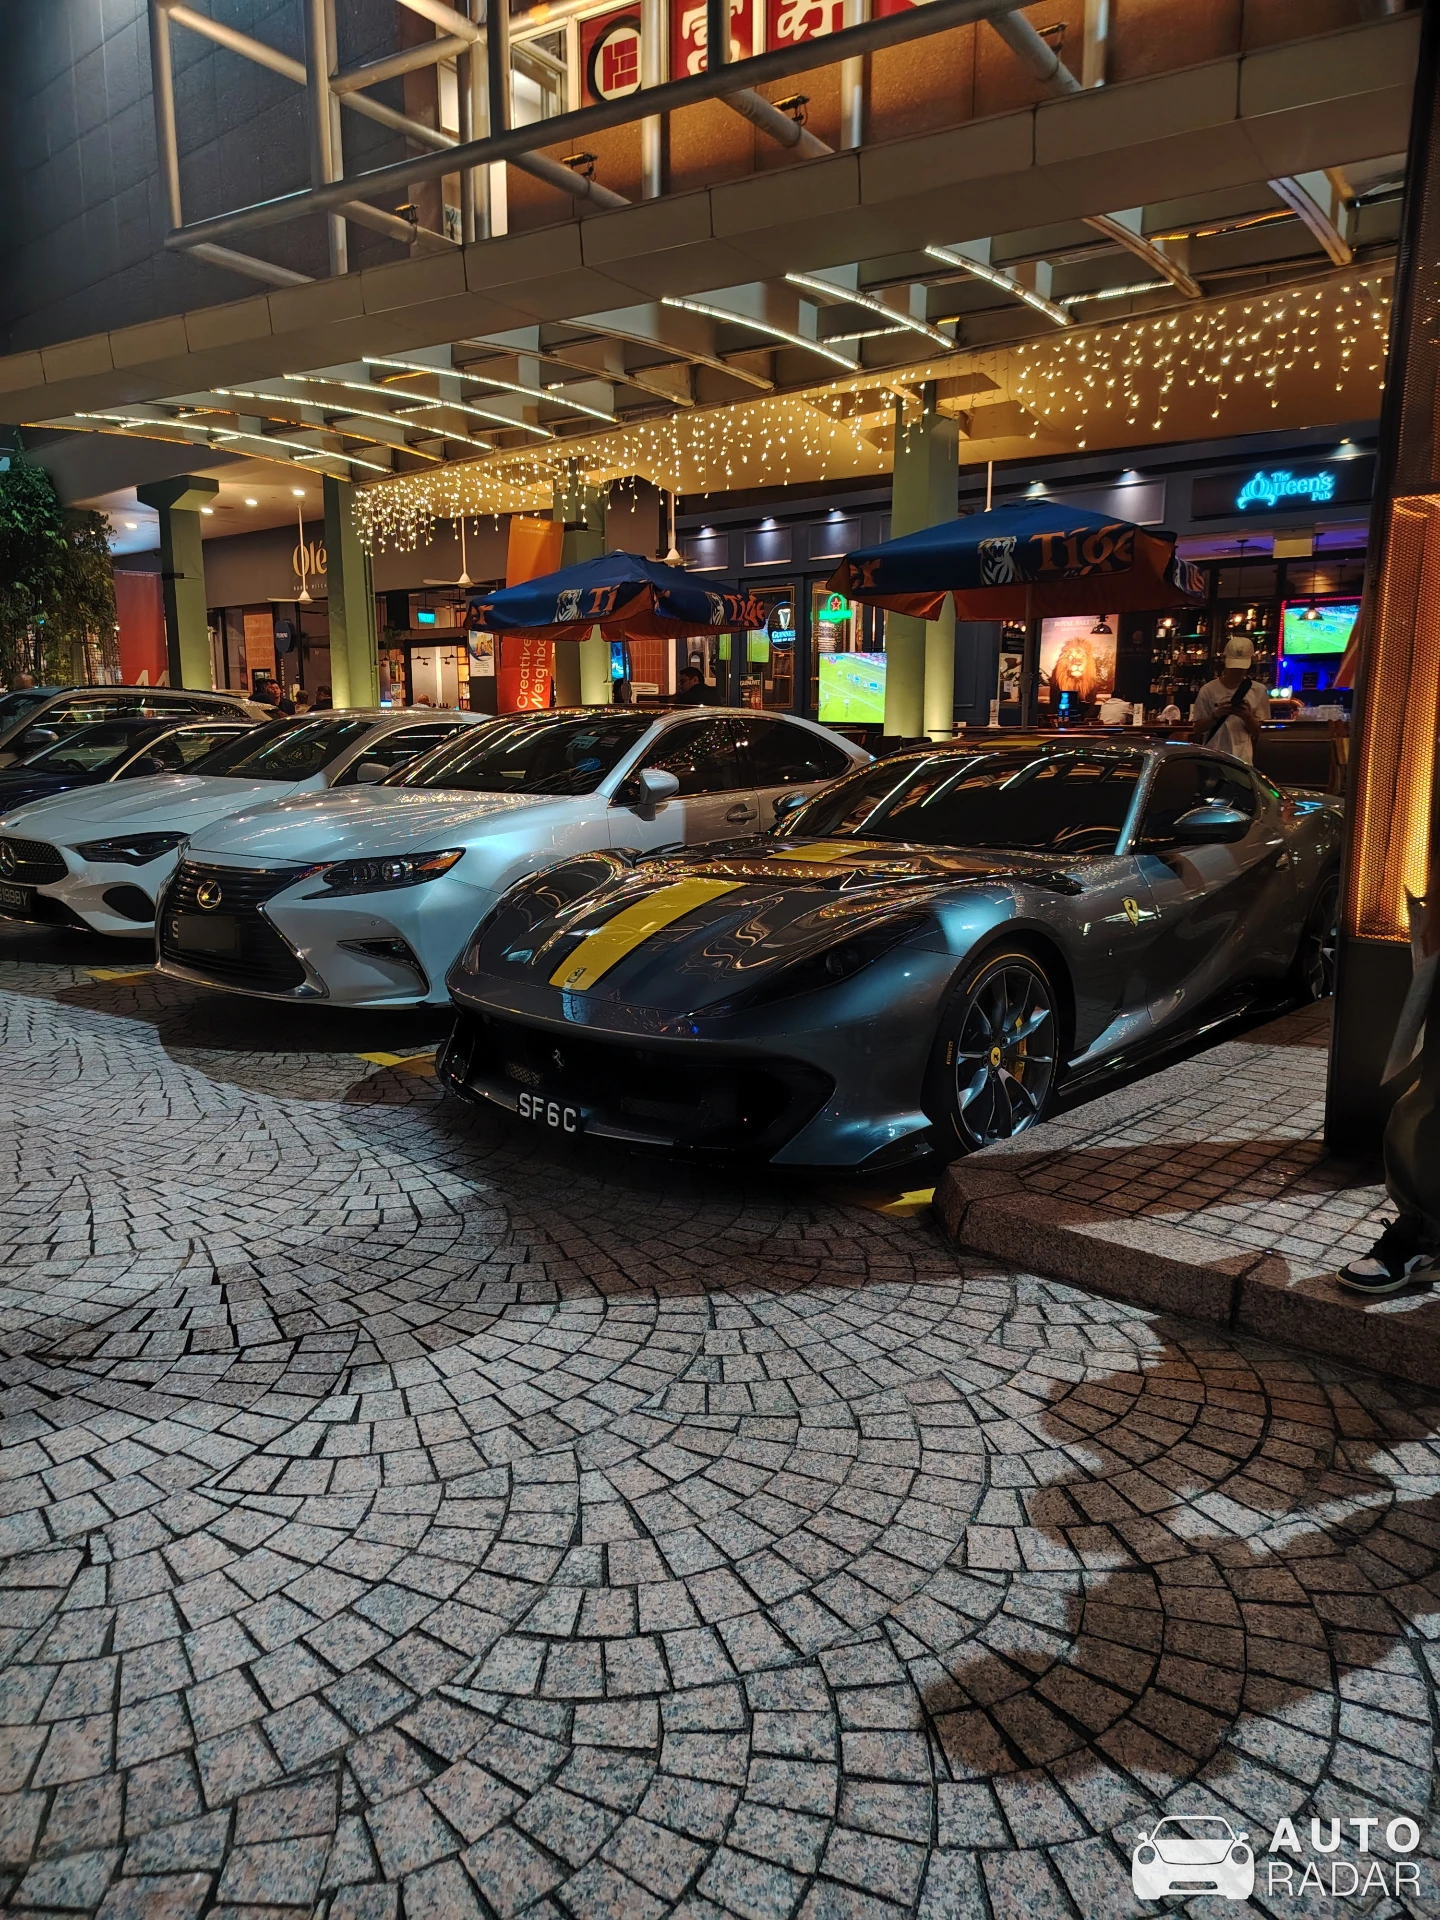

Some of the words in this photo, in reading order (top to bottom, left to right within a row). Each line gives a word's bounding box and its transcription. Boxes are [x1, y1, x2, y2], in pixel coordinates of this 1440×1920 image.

[1311, 490, 1333, 501] Pub
[292, 539, 328, 577] Olé
[516, 639, 532, 709] Creative
[519, 1092, 577, 1133] SF6C
